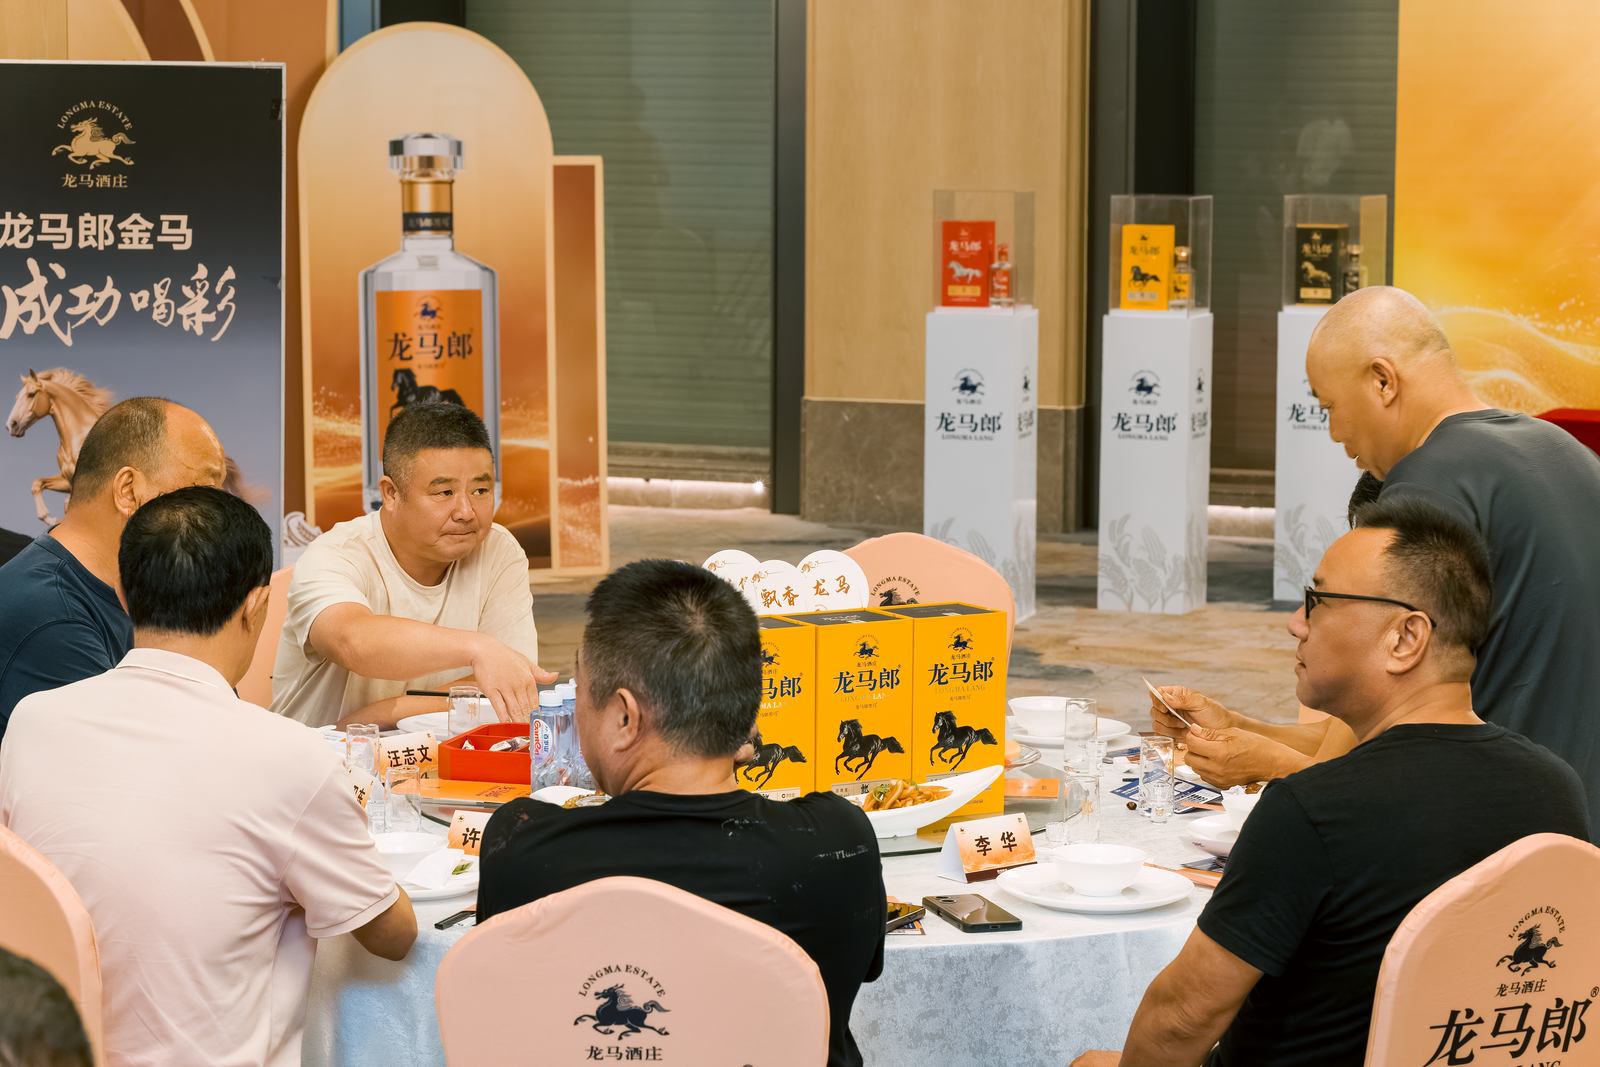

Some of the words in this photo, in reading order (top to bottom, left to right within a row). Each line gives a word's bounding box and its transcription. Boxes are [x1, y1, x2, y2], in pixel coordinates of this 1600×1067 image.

[57, 100, 96, 129] LONGMA
[98, 100, 133, 131] ESTATE
[62, 173, 128, 188] 龙马酒庄
[0, 211, 193, 251] 龙马郎金马
[387, 331, 473, 361] 龙马郎
[935, 411, 1002, 433] 龙马郎
[1111, 411, 1177, 433] 龙马郎
[1286, 403, 1328, 423] 龙马
[761, 585, 799, 608] 飘香
[813, 575, 850, 597] 龙马
[870, 576, 896, 596] LONGMA
[897, 576, 920, 596] ESTATE
[833, 668, 900, 694] 龙马郎
[927, 659, 994, 687] 龙马郎
[761, 675, 802, 700] 马郎
[387, 744, 432, 768] 汪志文
[974, 831, 1018, 857] 李华
[1508, 907, 1544, 940] LONGMA
[1545, 905, 1566, 934] ESTATE
[578, 964, 621, 997] LONGMA
[625, 964, 666, 997] ESTATE
[1495, 978, 1547, 997] 龙马酒庄
[1422, 997, 1593, 1067] 龙马郎
[585, 1045, 663, 1061] 龙马酒庄
